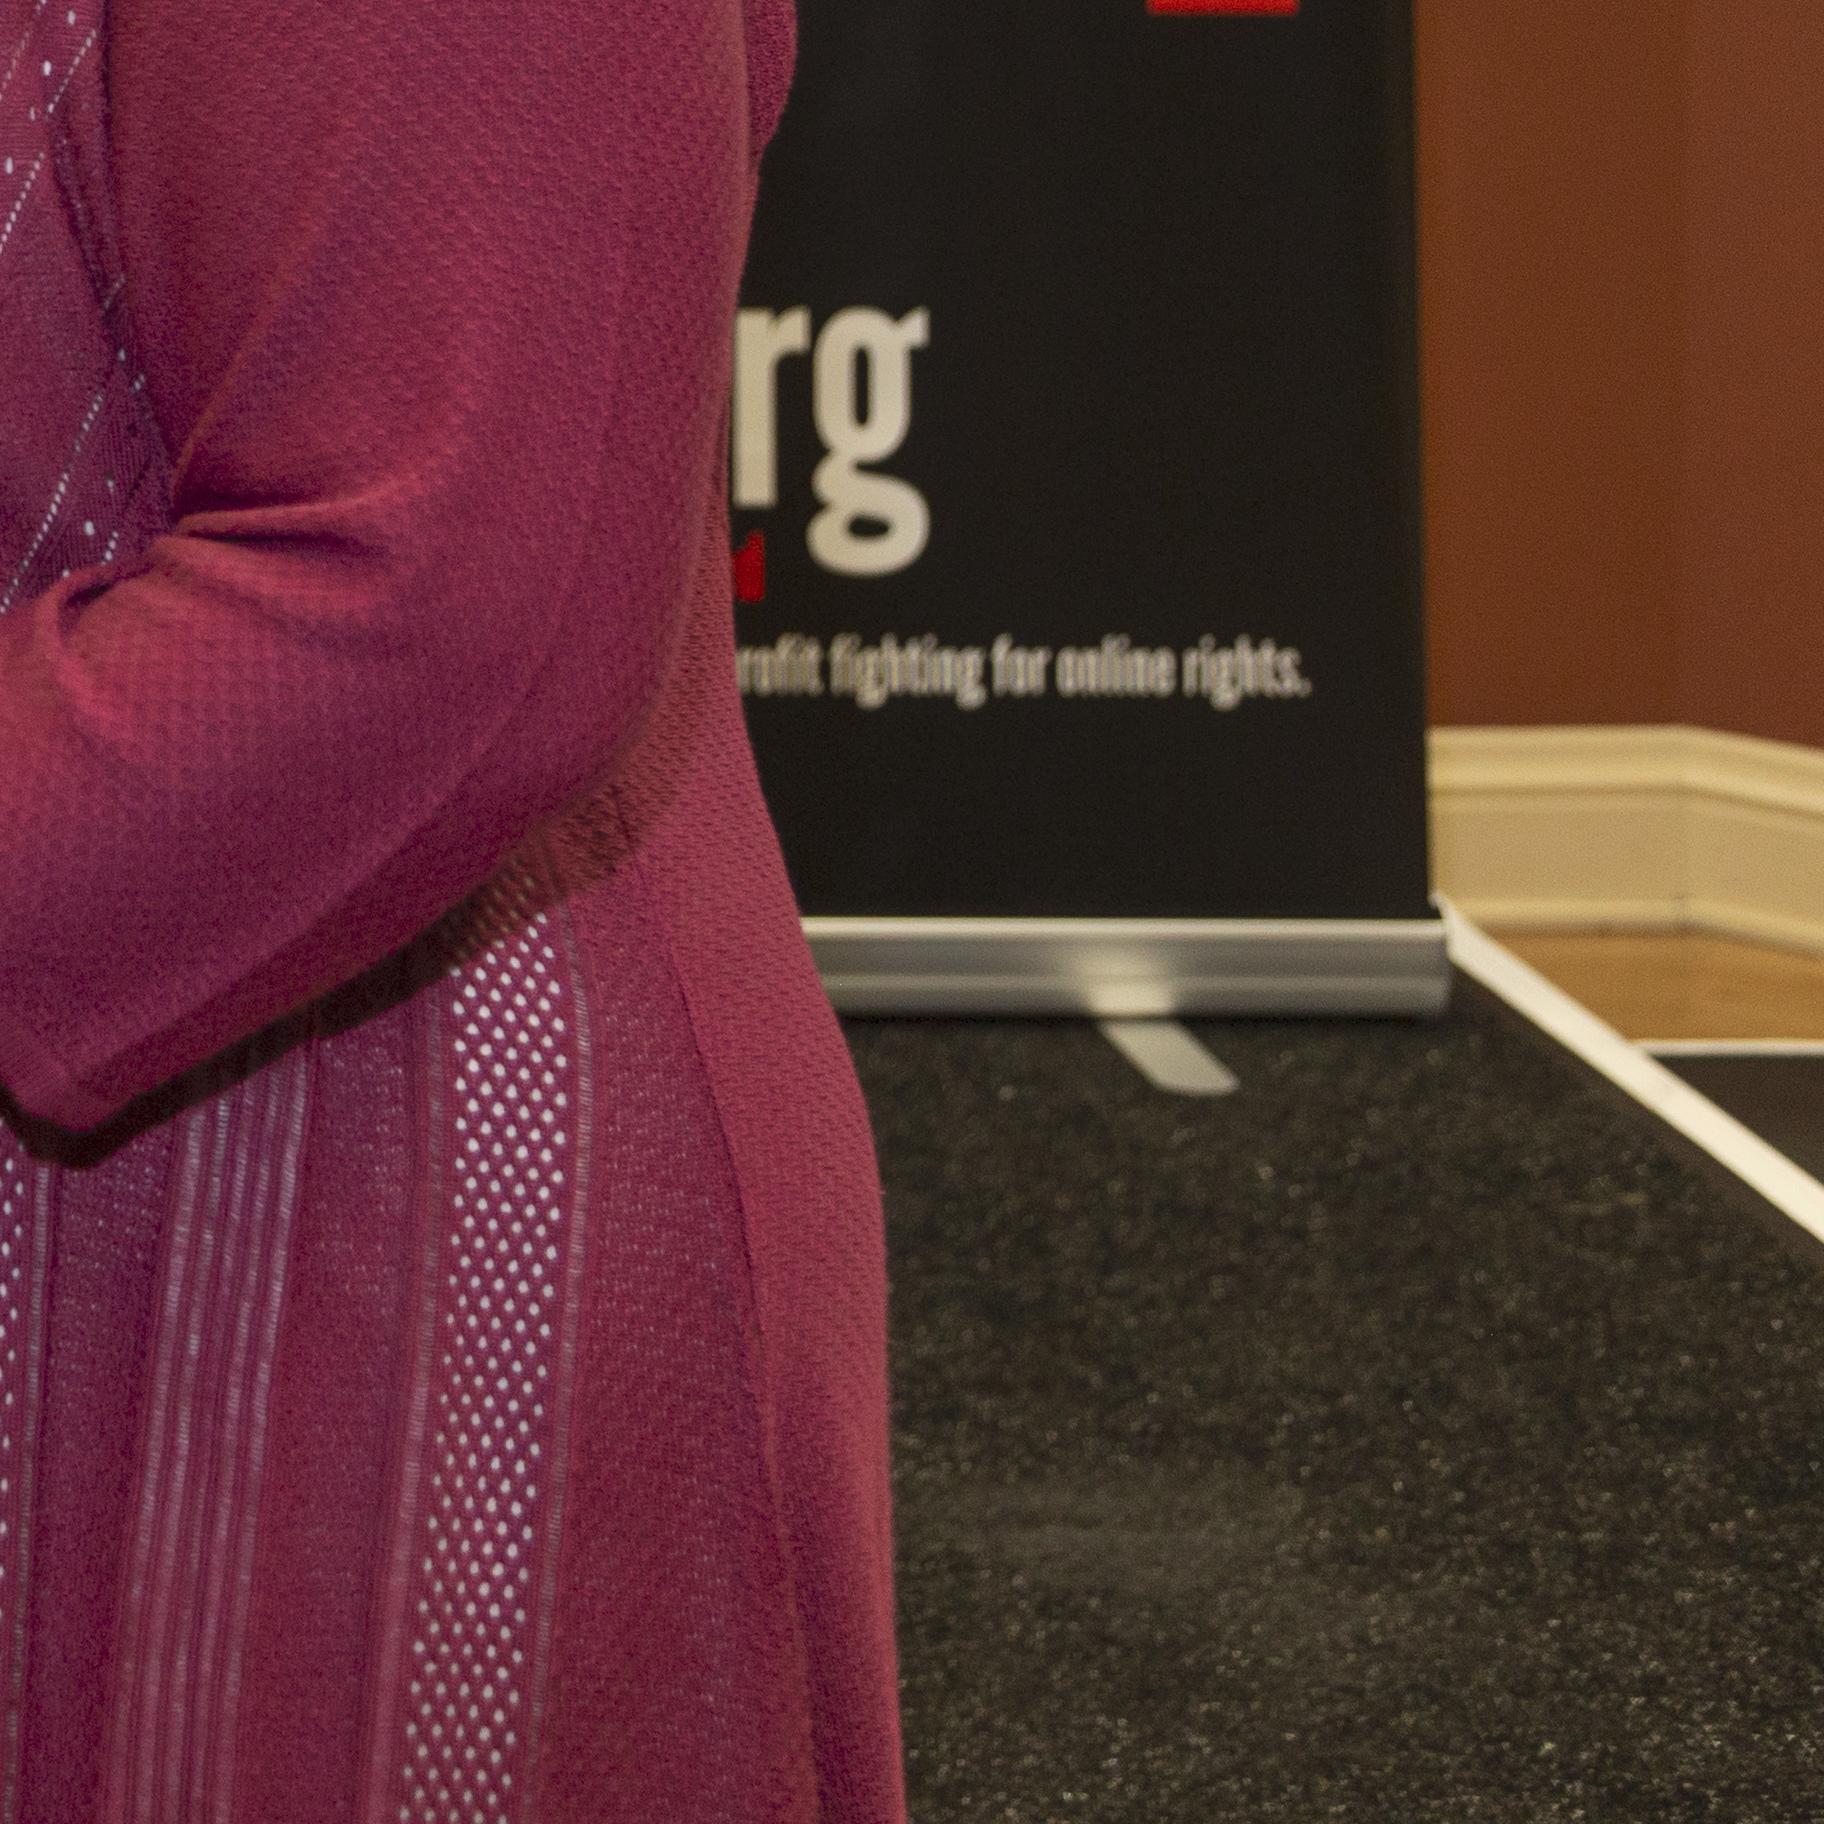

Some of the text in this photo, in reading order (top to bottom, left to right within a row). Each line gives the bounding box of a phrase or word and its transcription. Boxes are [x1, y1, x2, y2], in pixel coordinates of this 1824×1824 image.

[830, 632, 988, 711] fighting
[992, 632, 1051, 697] for
[1056, 632, 1178, 697] online
[1182, 632, 1314, 712] rights.
